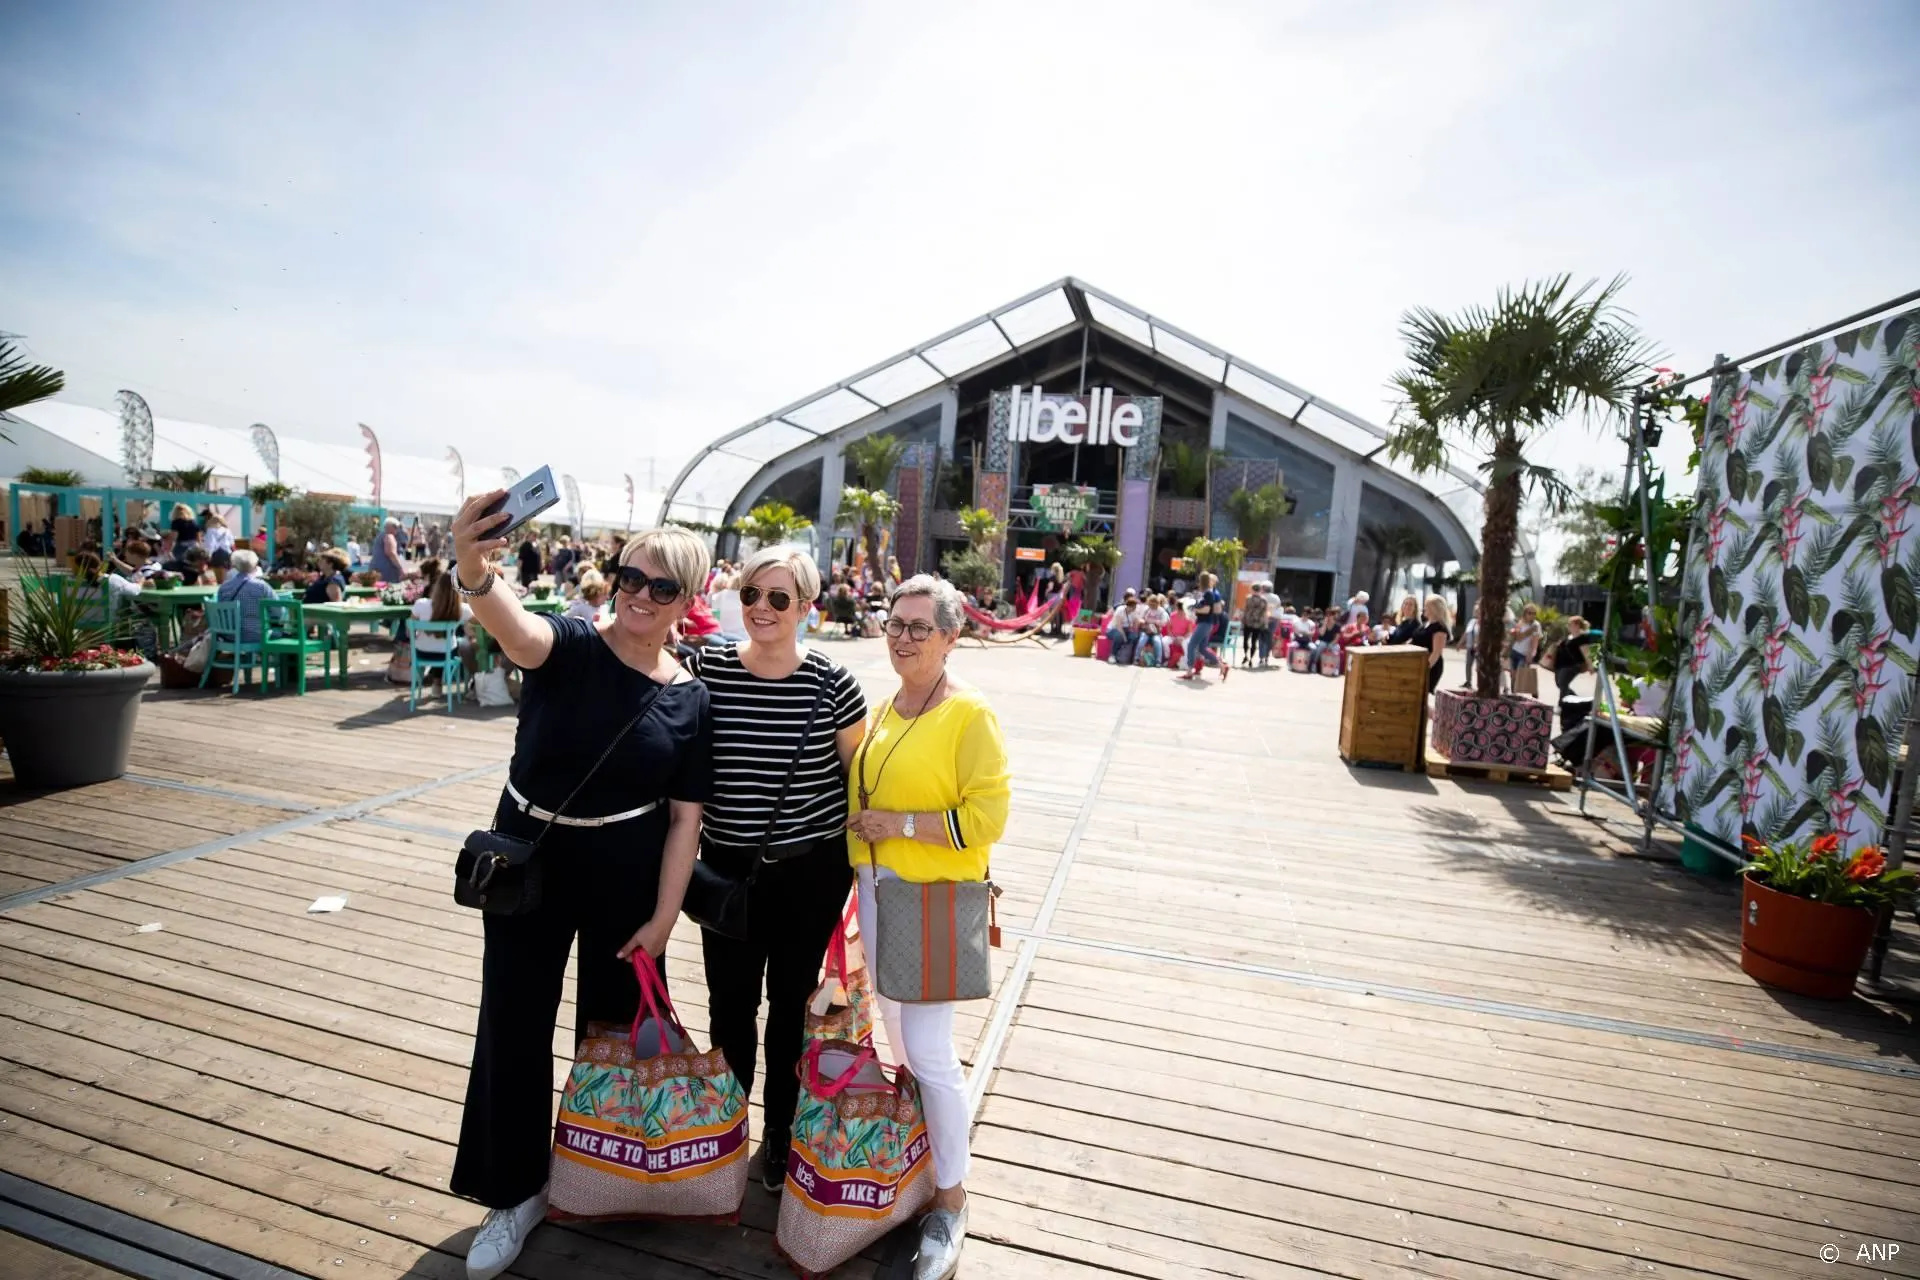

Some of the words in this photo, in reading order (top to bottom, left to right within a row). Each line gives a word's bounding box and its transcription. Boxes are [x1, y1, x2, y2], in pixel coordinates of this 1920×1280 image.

[1008, 384, 1143, 447] libelle
[1040, 494, 1088, 510] TROPICAL
[1046, 508, 1078, 520] PARTY
[566, 1129, 600, 1153] TAKE
[600, 1138, 622, 1159] ME
[624, 1143, 643, 1164] TO
[648, 1151, 668, 1170] HE
[670, 1140, 719, 1166] BEACH
[910, 1135, 928, 1161] BEA
[841, 1183, 876, 1204] TAKE
[878, 1186, 896, 1206] ME
